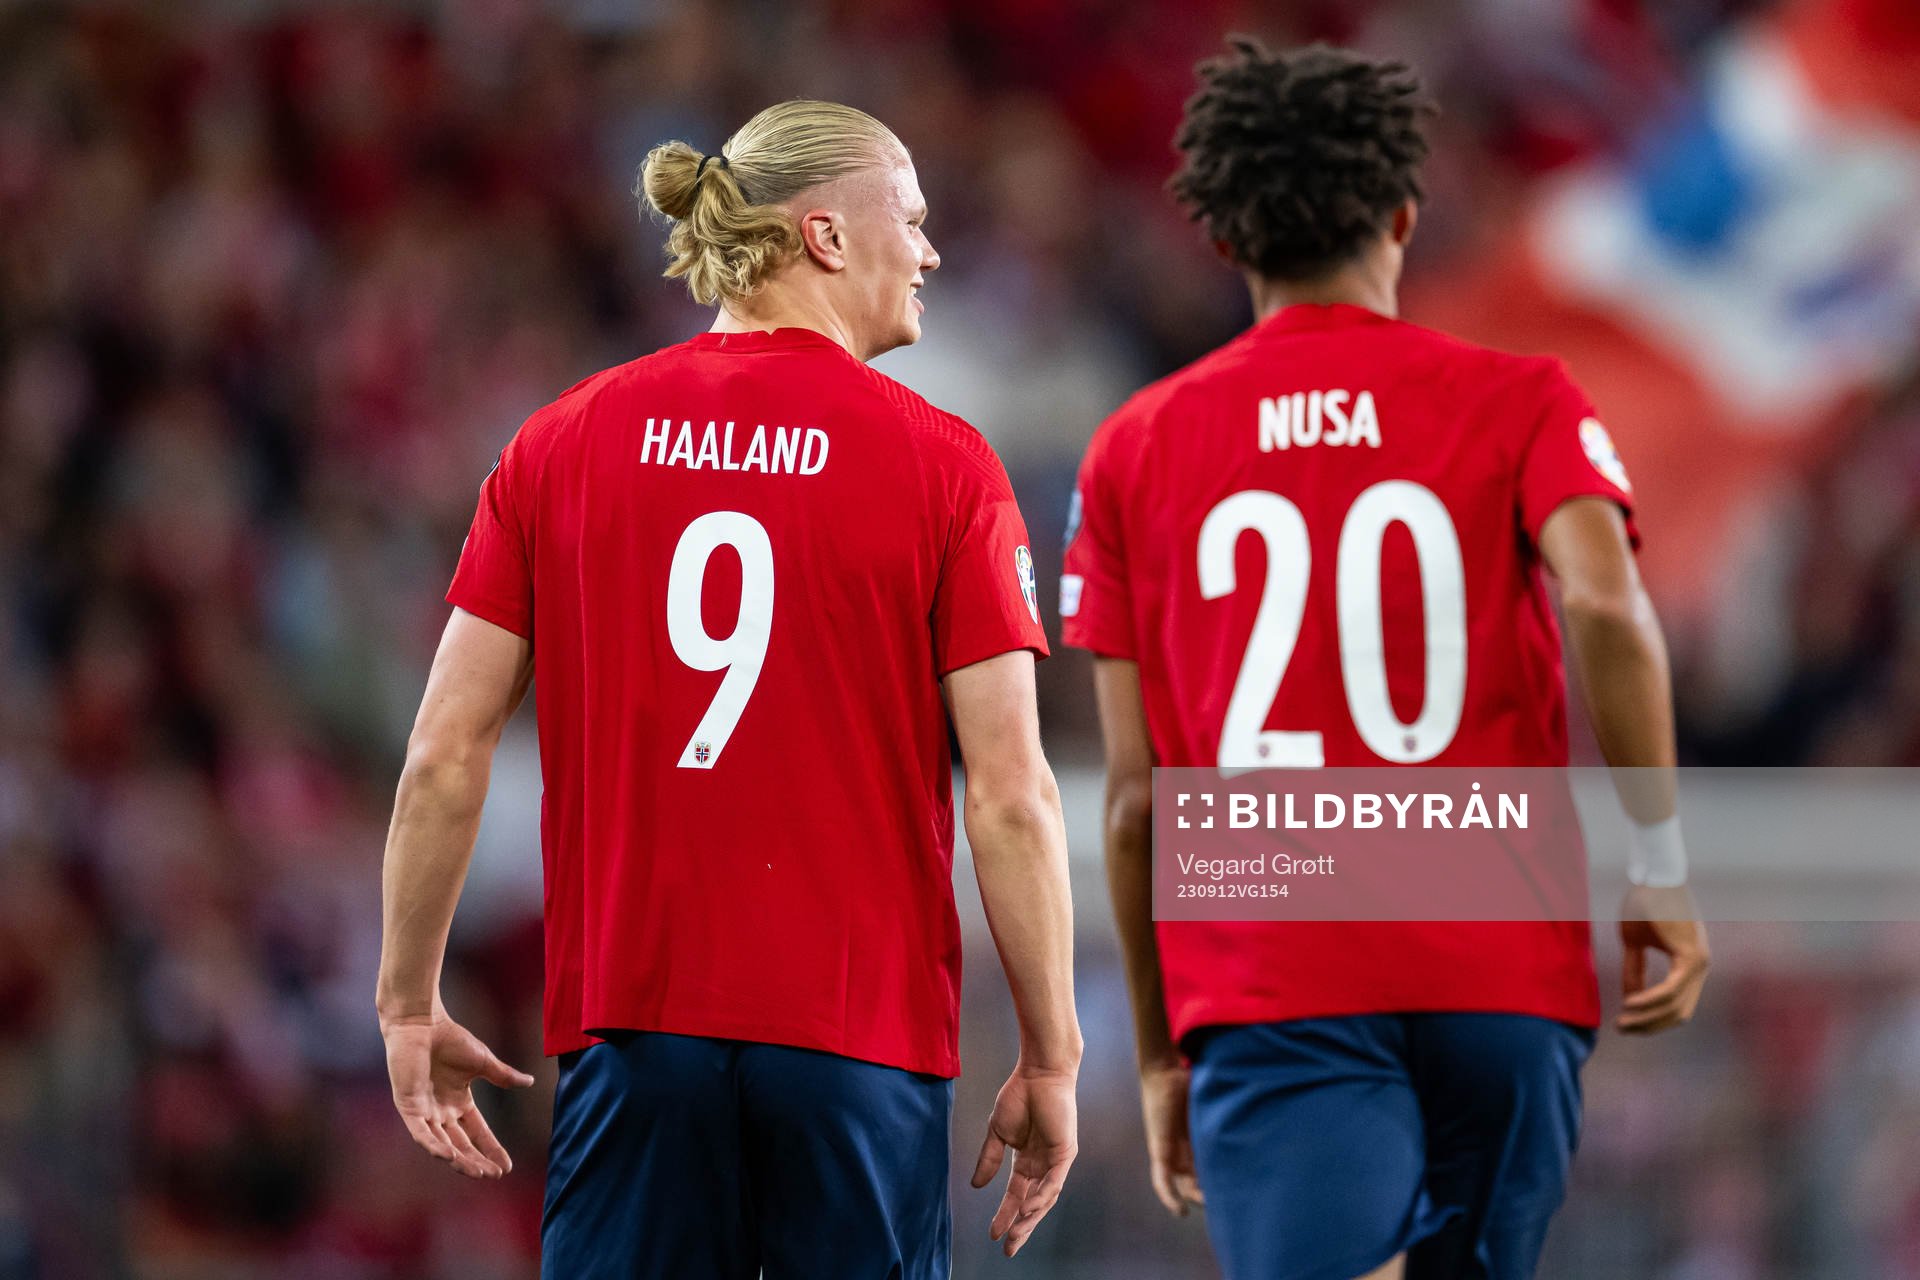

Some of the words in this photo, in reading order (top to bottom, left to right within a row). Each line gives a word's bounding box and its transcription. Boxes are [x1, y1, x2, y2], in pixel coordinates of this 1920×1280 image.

[640, 417, 830, 477] HAALAND
[1258, 388, 1382, 453] NUSA
[666, 510, 775, 771] 9
[1197, 480, 1467, 779] 20
